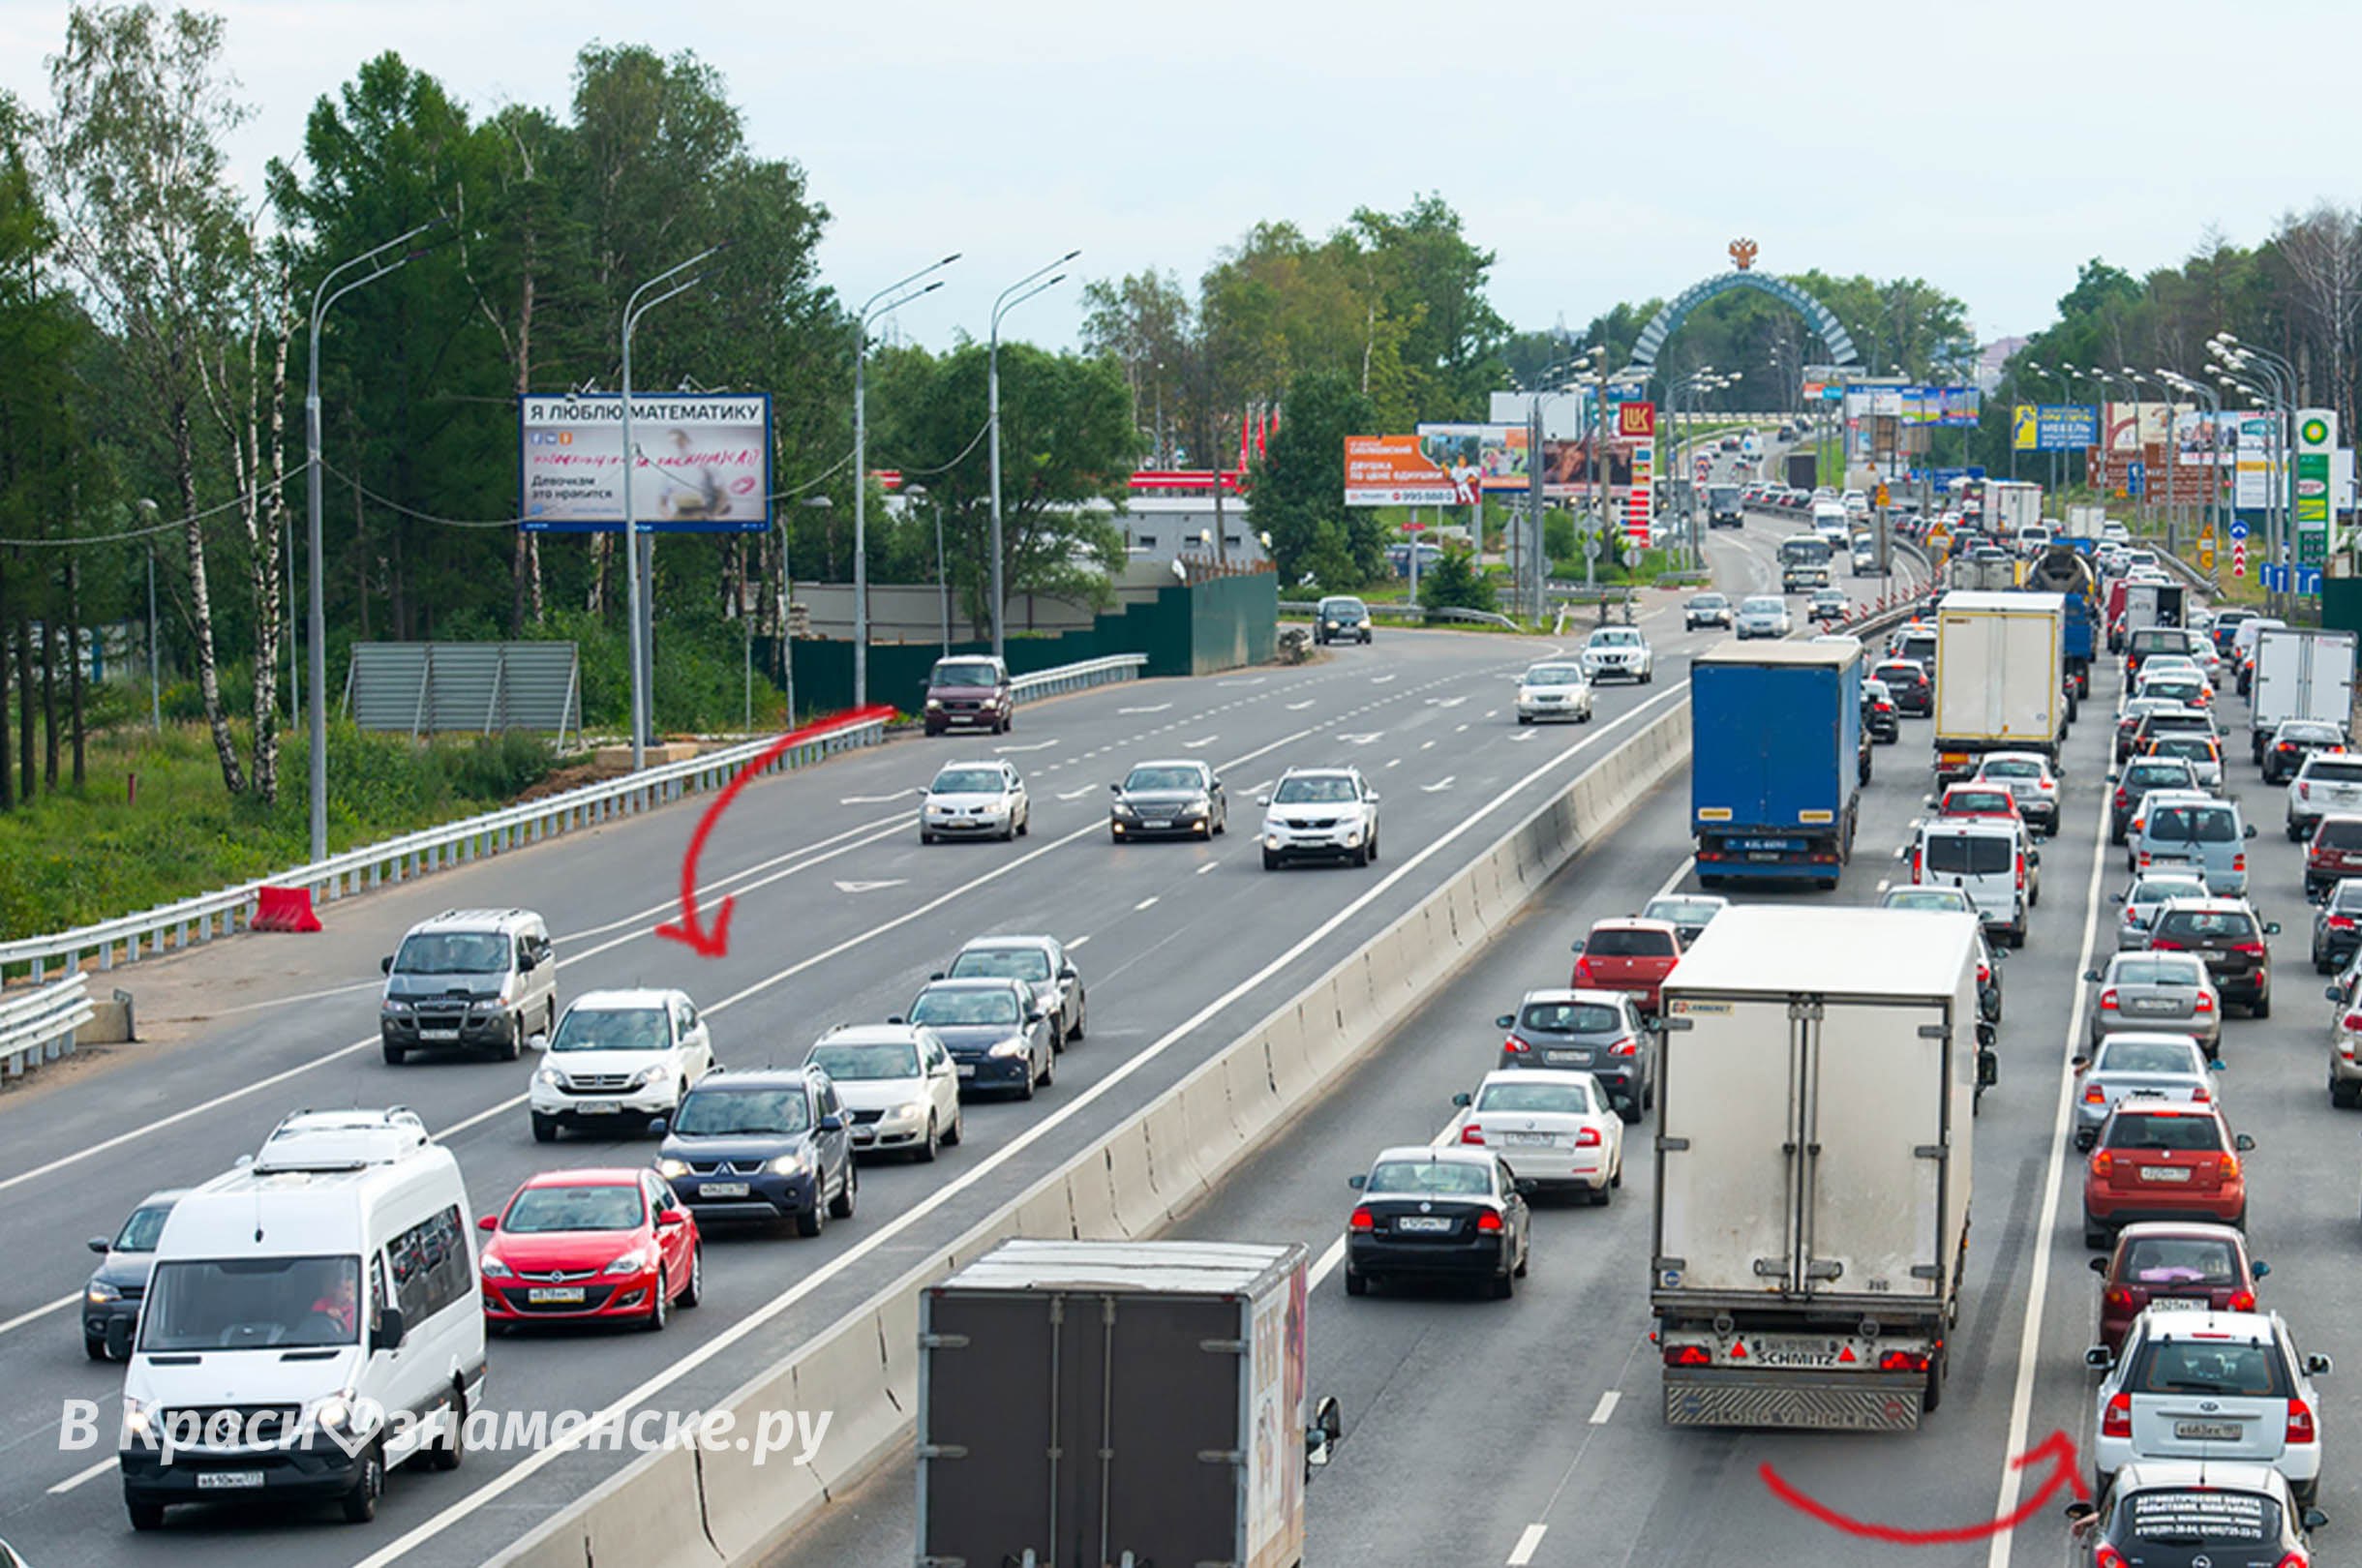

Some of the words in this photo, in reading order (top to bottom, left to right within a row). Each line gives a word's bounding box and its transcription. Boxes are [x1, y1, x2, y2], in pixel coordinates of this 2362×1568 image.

[530, 405, 544, 420] Я
[549, 405, 624, 420] ЛЮБЛЮ
[629, 404, 759, 420] МАТЕМАТИКУ
[531, 474, 595, 487] Девочкам
[531, 489, 553, 500] это
[556, 489, 613, 501] нравится
[1756, 1351, 1835, 1366] SCHMITZ
[1719, 1409, 1772, 1425] LONG
[1779, 1410, 1868, 1427] VEHICLE
